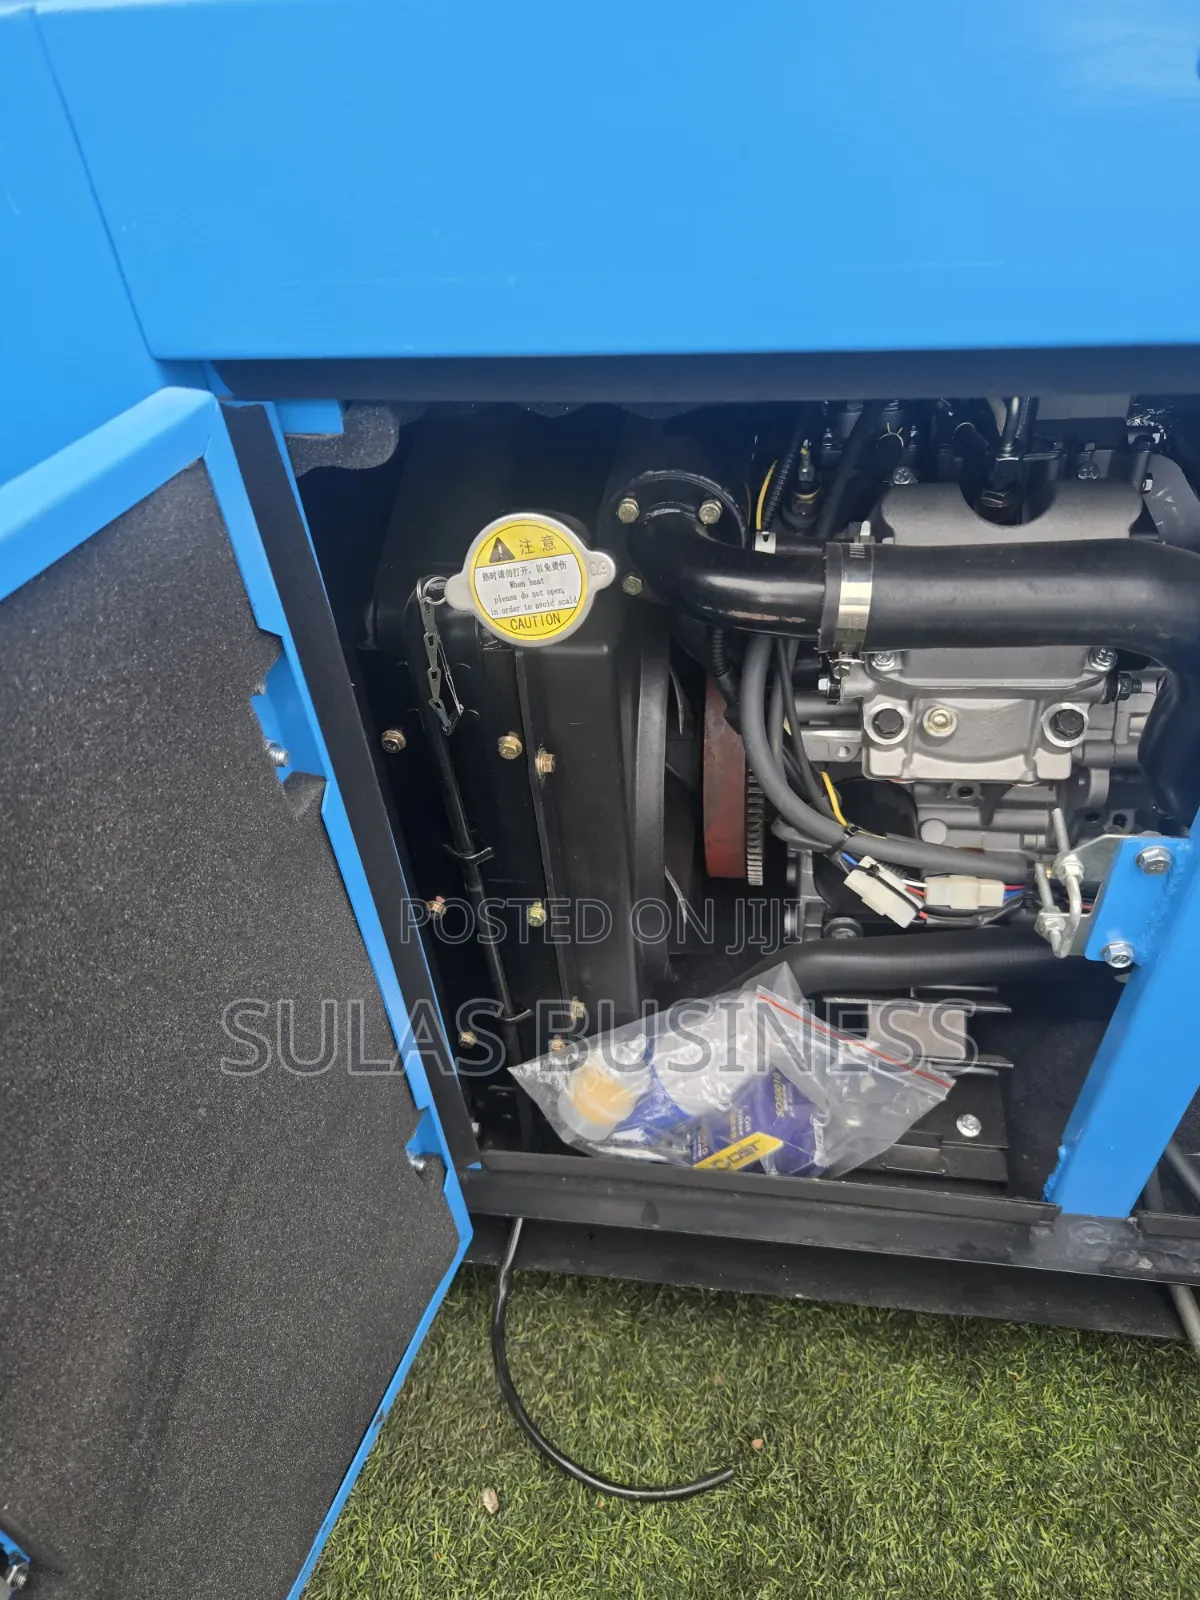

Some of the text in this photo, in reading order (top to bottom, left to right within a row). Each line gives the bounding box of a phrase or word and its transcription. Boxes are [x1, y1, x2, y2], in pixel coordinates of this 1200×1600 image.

[519, 534, 557, 556] 注意
[509, 578, 544, 589] When heat
[490, 608, 499, 616] in
[501, 605, 521, 615] order
[535, 599, 555, 609] avoid
[558, 596, 578, 606] scald
[494, 594, 518, 605] please
[520, 591, 529, 599] do
[532, 590, 544, 598] not
[510, 612, 561, 631] CAUTION
